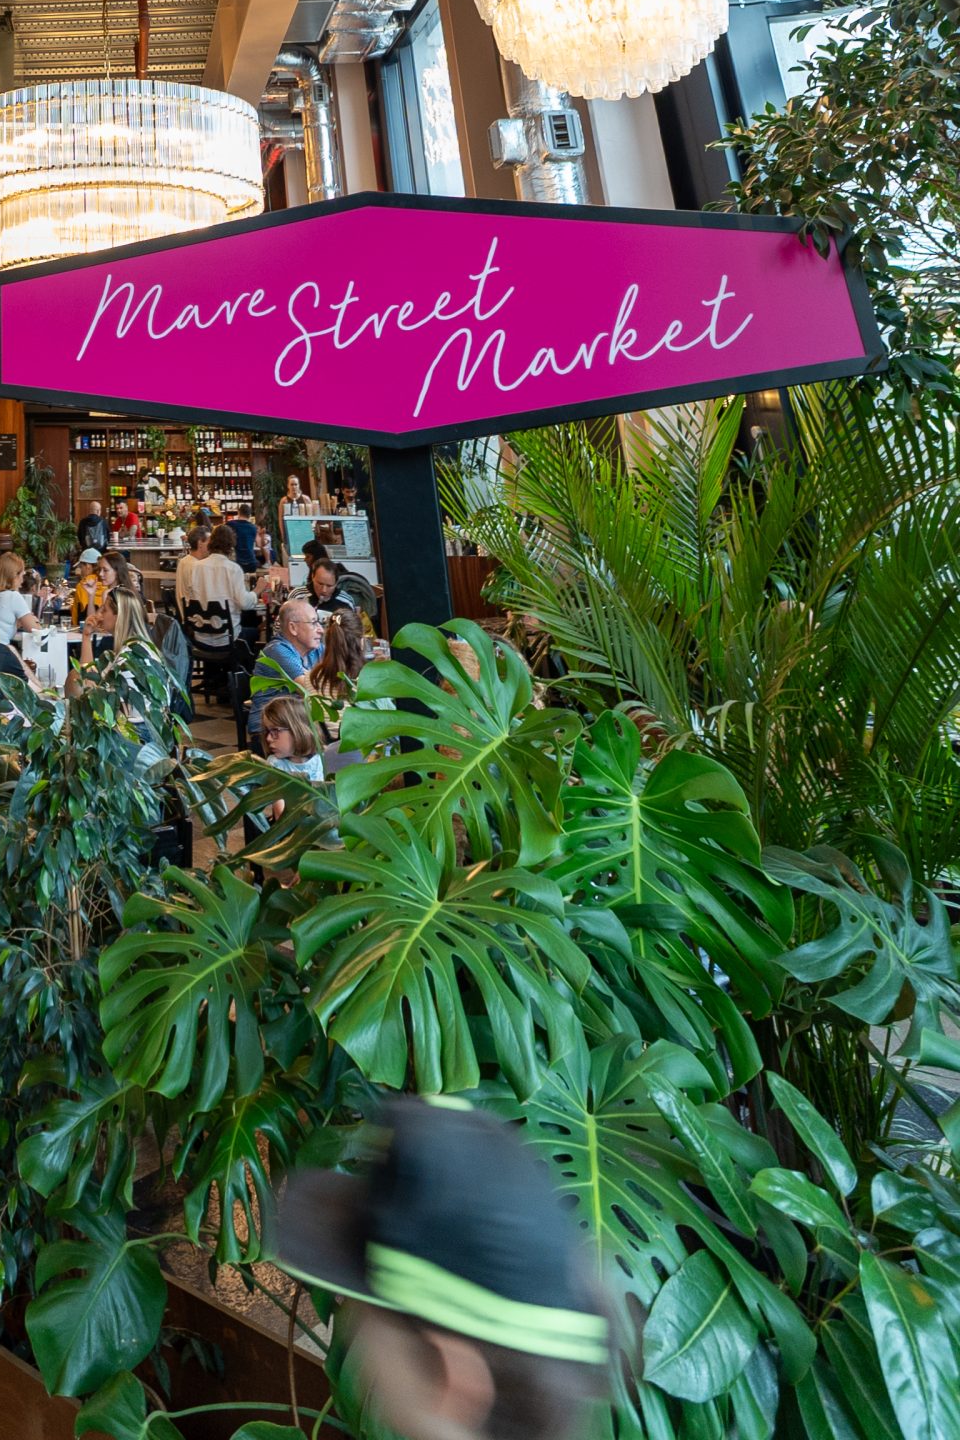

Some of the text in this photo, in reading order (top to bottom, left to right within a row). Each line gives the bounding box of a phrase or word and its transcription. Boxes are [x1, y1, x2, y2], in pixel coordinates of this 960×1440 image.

[76, 236, 515, 387] Mare Street
[413, 274, 754, 418] Market
